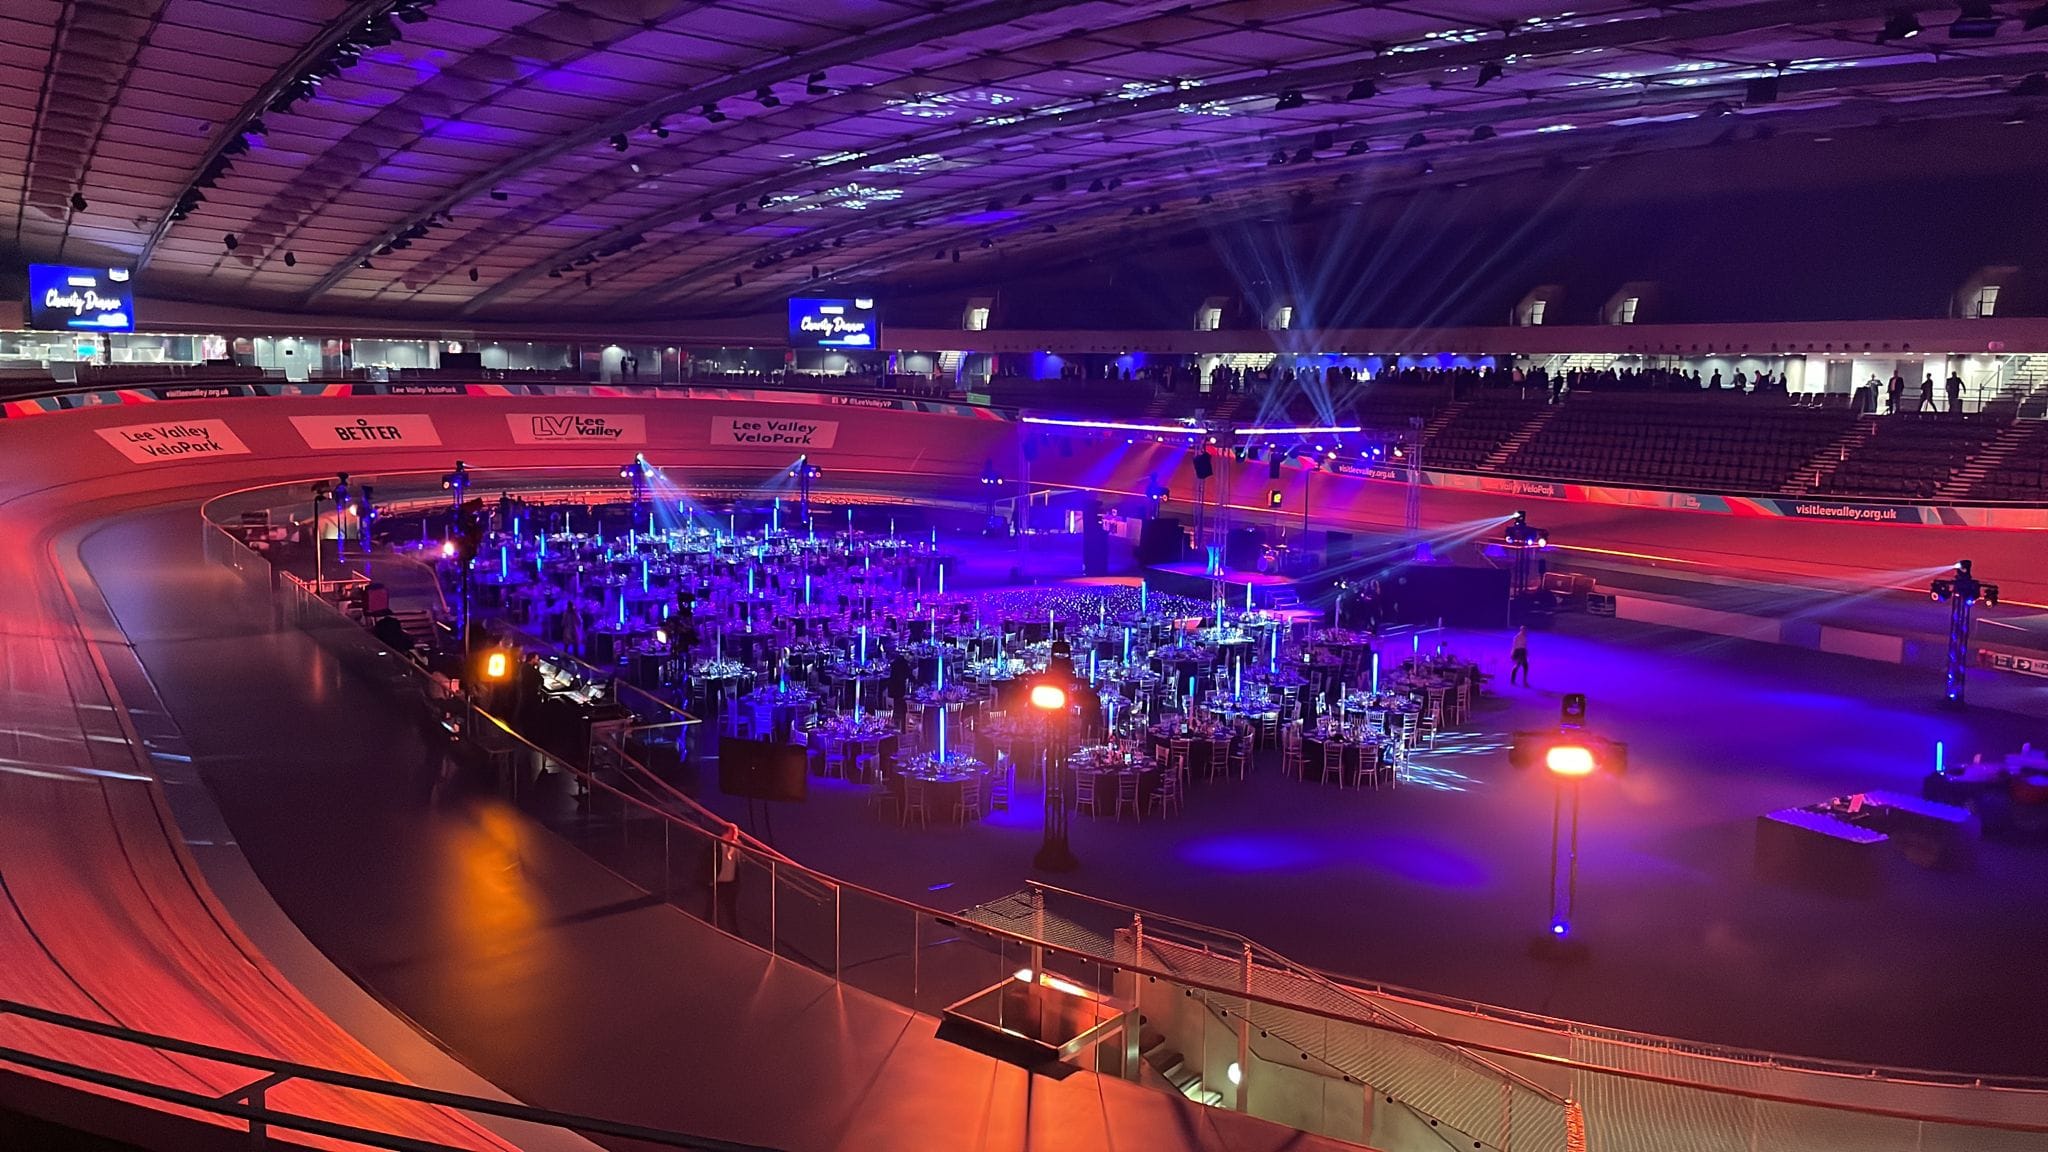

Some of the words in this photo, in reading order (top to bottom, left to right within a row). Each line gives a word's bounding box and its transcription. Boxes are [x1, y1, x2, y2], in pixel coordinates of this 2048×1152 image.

[576, 416, 605, 426] Lee
[733, 420, 762, 430] Lee
[767, 421, 817, 435] Valley
[121, 431, 157, 443] Lee
[152, 425, 209, 439] Valley
[335, 418, 402, 440] BETTER
[576, 426, 622, 437] Valley
[733, 432, 811, 445] VeloPark
[140, 440, 223, 457] VeloPark
[1522, 483, 1554, 495] VeloPark
[1796, 505, 1897, 521] visitleevalley.org.uk
